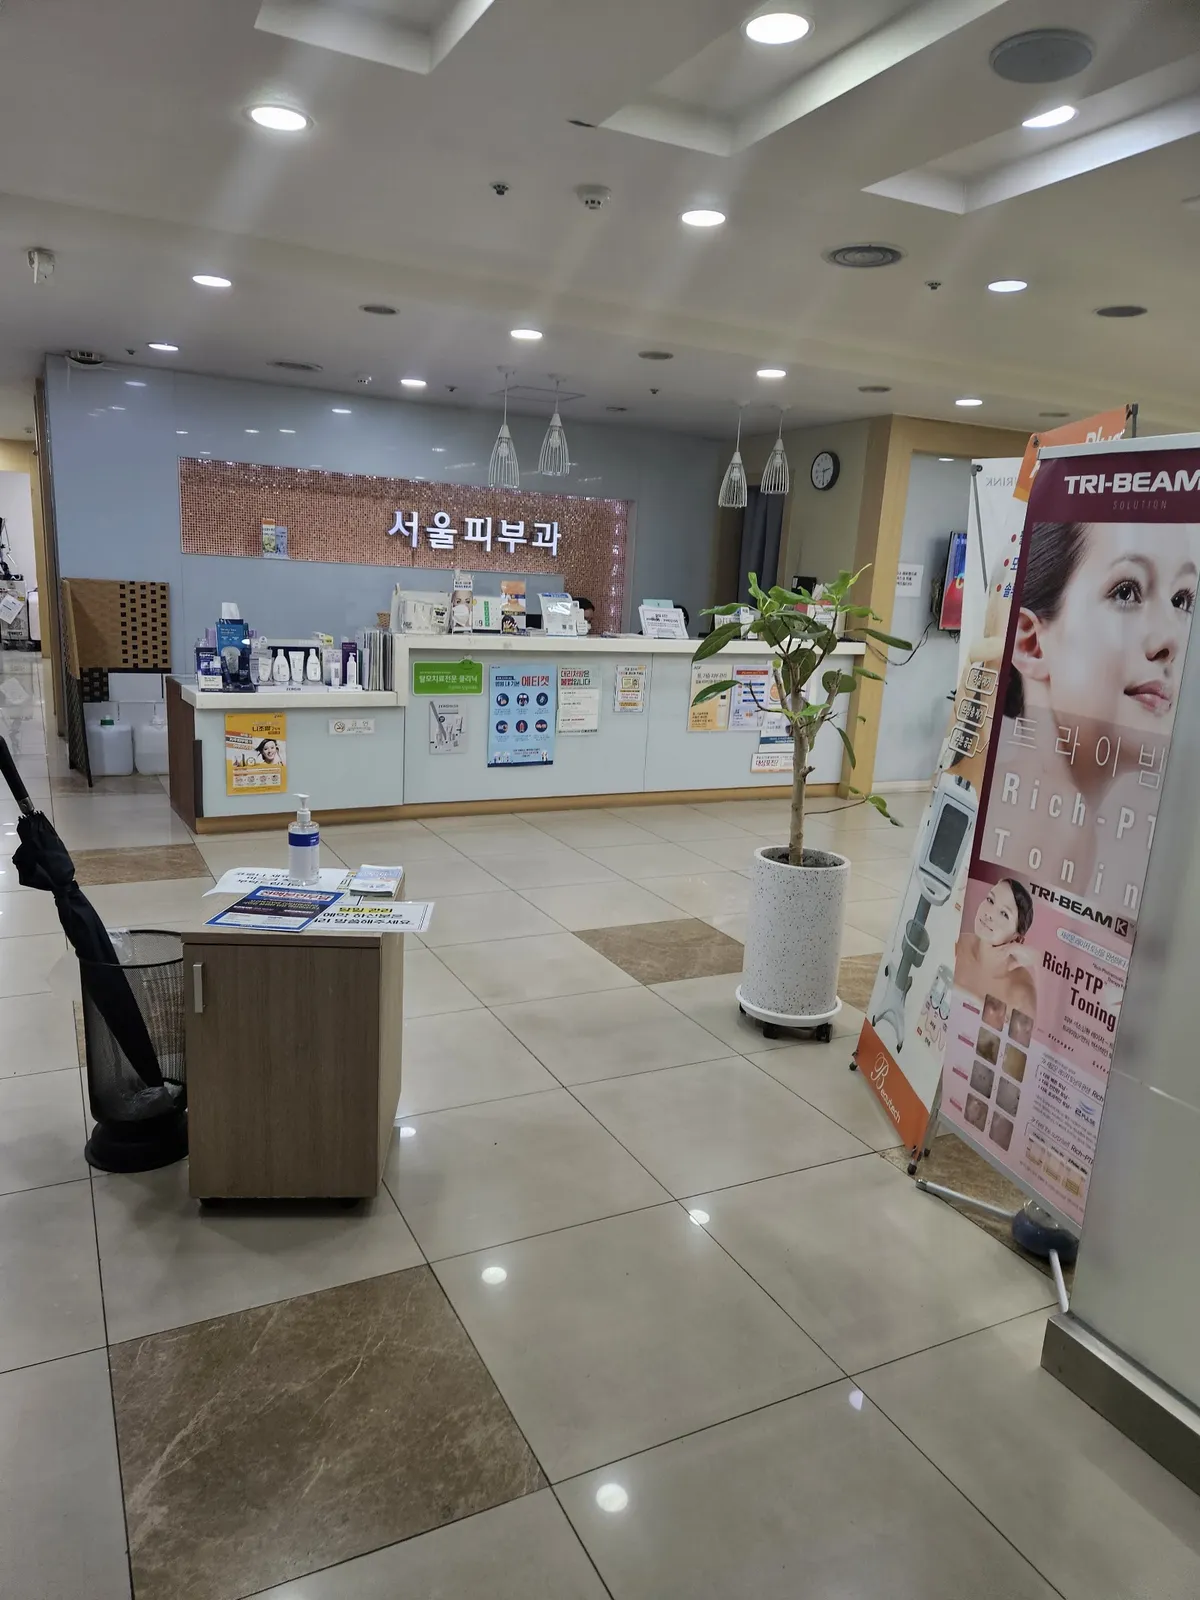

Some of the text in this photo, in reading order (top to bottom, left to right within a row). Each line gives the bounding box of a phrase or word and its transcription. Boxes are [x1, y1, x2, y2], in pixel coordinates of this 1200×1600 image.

[1064, 469, 1200, 495] TRI-BEAM
[1113, 500, 1168, 512] SOLUTION
[388, 508, 562, 556] 서울피부과
[521, 675, 550, 687] 에티켓
[1006, 717, 1167, 790] 트라이빔
[1030, 884, 1113, 927] TRI-BEAM
[1042, 951, 1103, 995] Rich-PTP
[1071, 987, 1116, 1032] Toning
